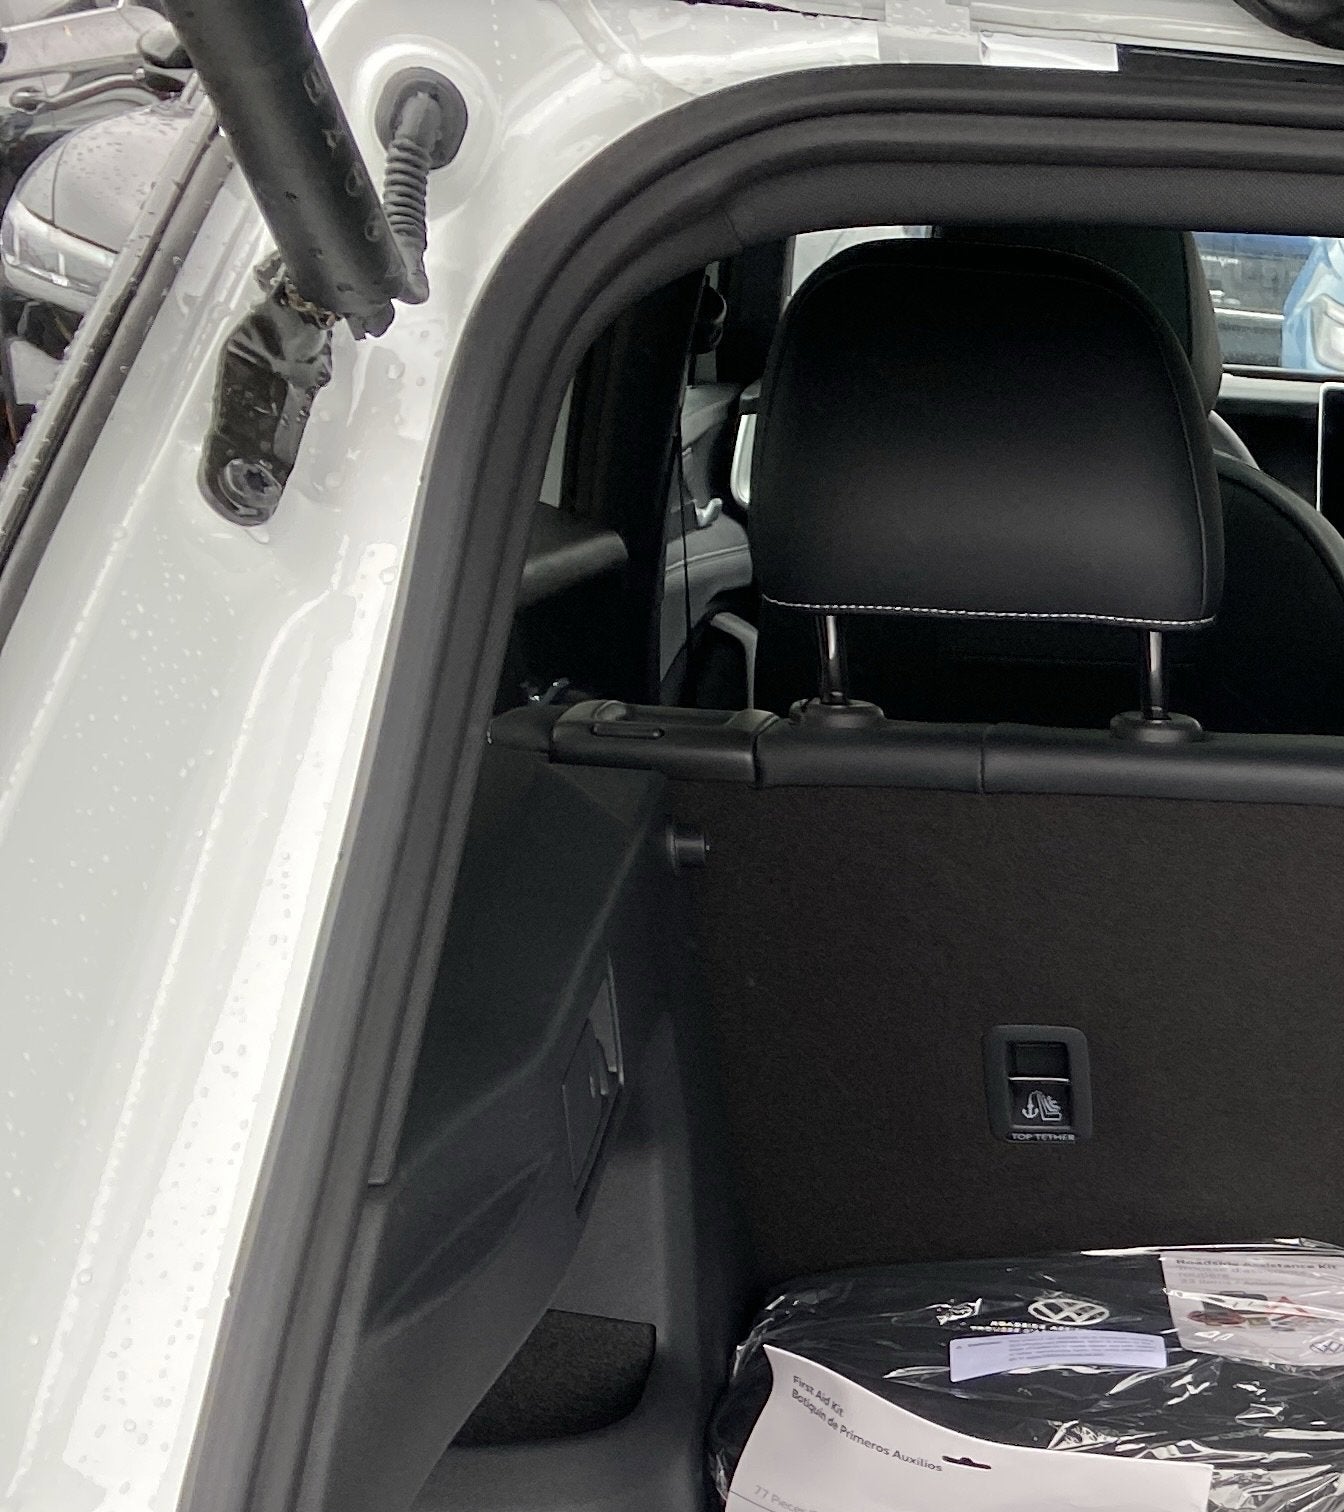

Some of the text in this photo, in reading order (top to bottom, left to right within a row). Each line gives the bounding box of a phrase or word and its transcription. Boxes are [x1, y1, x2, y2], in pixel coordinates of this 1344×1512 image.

[1011, 1132, 1075, 1141] TOP TETHER
[792, 1375, 845, 1418] First Aid Kit
[827, 1416, 839, 1431] de
[839, 1424, 890, 1457] Primeros
[892, 1449, 943, 1472] Auxilios
[753, 1485, 769, 1500] 77
